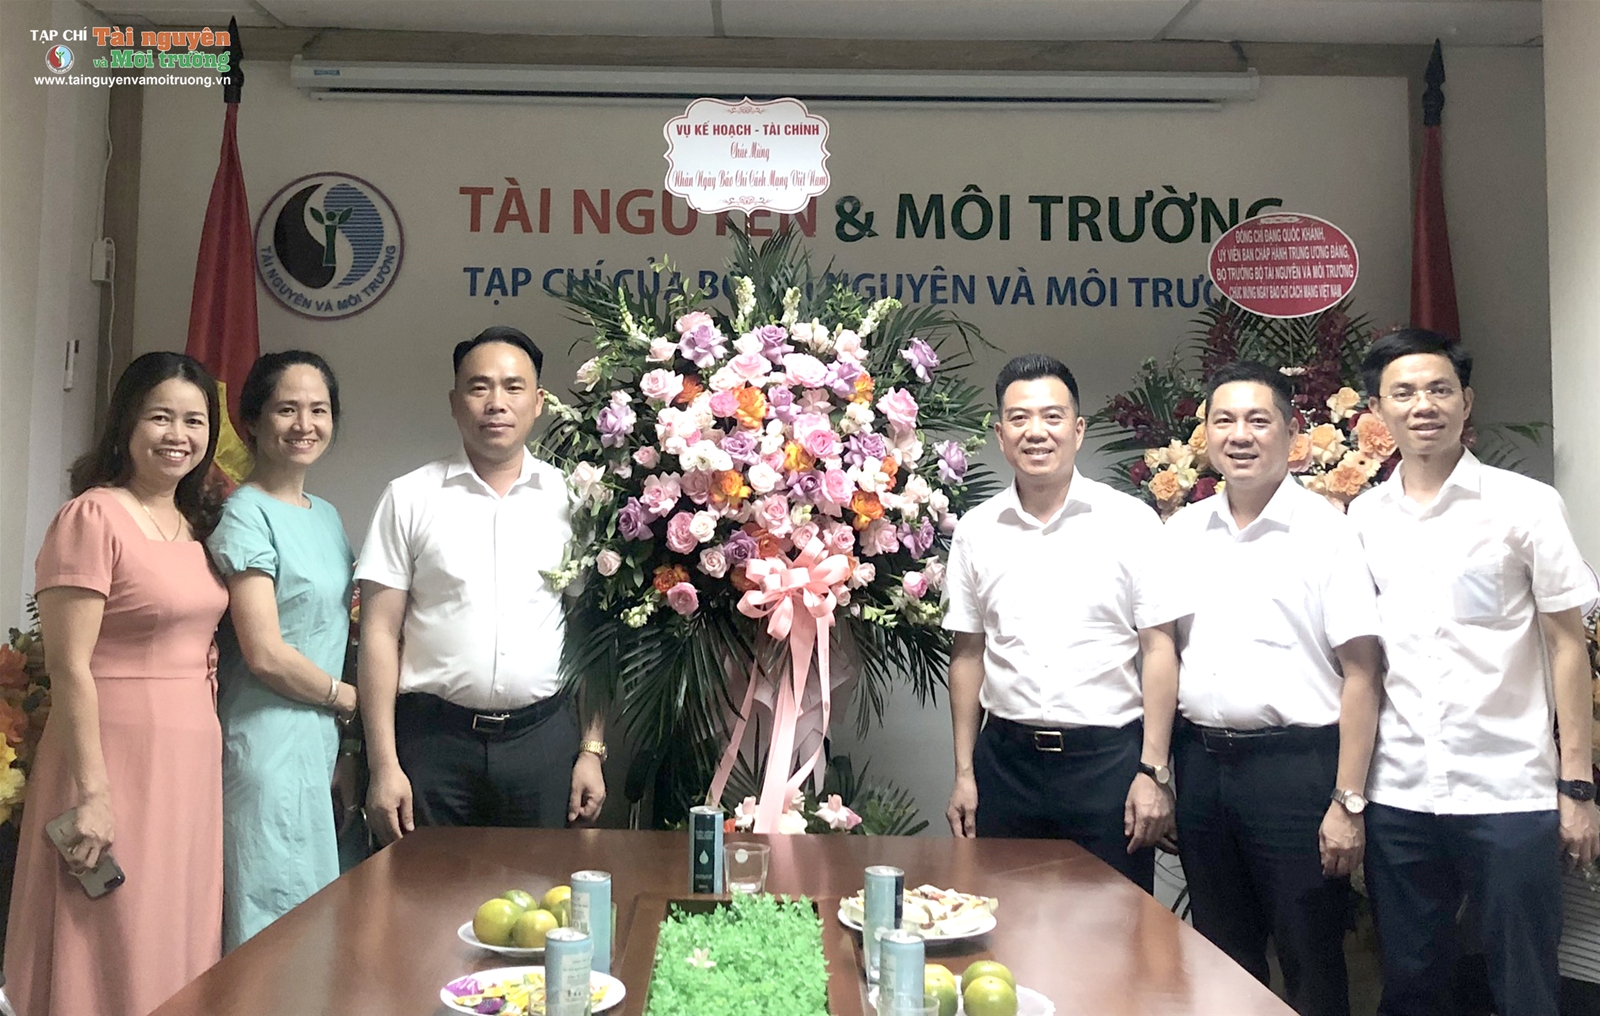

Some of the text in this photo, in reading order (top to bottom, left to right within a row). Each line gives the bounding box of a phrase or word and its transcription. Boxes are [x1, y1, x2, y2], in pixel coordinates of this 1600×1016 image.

[676, 124, 691, 138] VỤ
[694, 120, 711, 136] KẾ
[713, 124, 751, 138] HOẠCH
[763, 121, 781, 136] TÀI
[784, 121, 820, 136] CHÍNH
[730, 141, 770, 162] Chúc Mừng
[695, 169, 717, 191] Ngày
[459, 177, 551, 234] TÀI
[573, 187, 818, 238] NGUN
[835, 195, 879, 242] &
[896, 184, 1010, 242] MÔI
[1288, 245, 1310, 260] TRUNG
[261, 244, 397, 312] TÀI NGUYÊN VÀ MÔI TRƯỜNG
[1275, 262, 1301, 280] NGUYÊN
[1302, 261, 1312, 279] VÀ
[1312, 261, 1325, 279] MÔI
[463, 267, 532, 306] TẠP
[986, 266, 1035, 306] VÀ
[1046, 268, 1118, 308] MÔI
